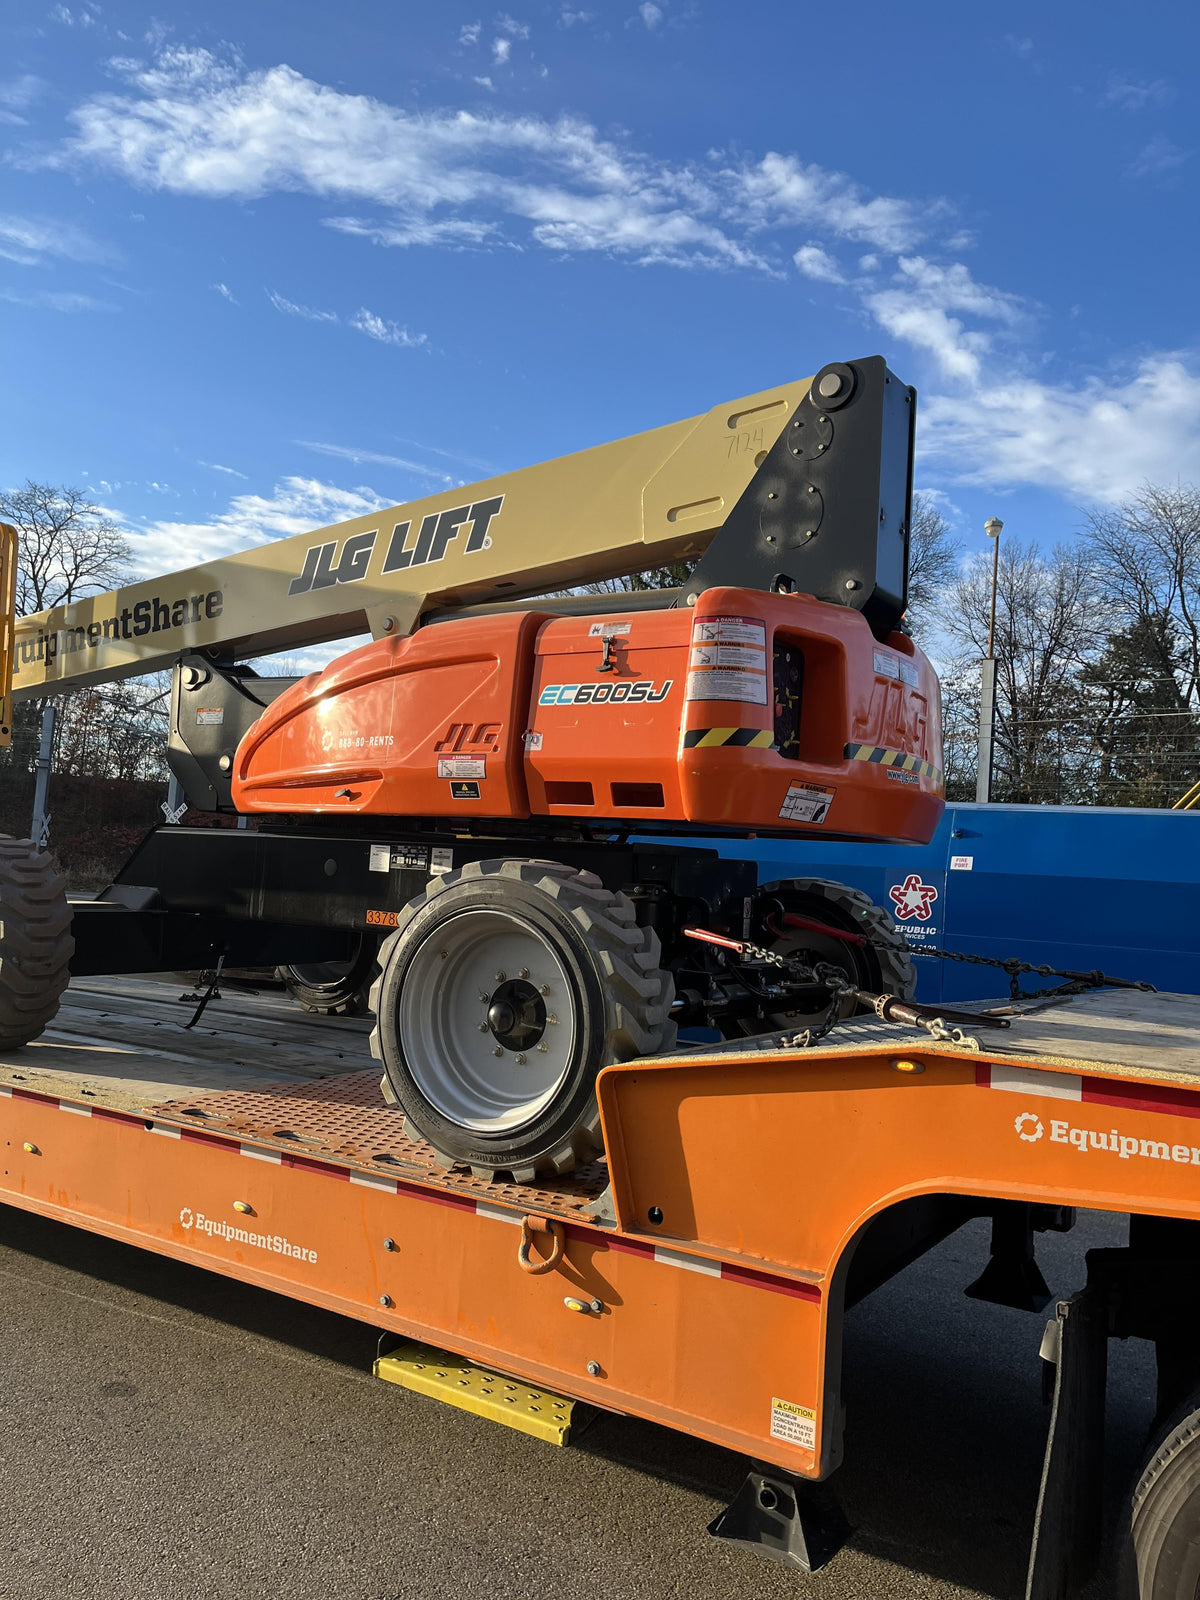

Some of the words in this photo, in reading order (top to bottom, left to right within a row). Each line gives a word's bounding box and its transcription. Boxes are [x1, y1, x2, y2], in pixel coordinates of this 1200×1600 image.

[722, 427, 764, 459] 7124
[288, 529, 379, 597] JLG
[381, 494, 505, 575] LIFT
[13, 590, 223, 674] uipmentShare
[539, 680, 673, 705] EC600SJ
[434, 723, 503, 753] JLG
[367, 911, 399, 926] 3378
[895, 925, 937, 935] EPUBLIC
[195, 1213, 318, 1264] EquipmentShare
[774, 1410, 797, 1420] MAXIMUM
[783, 1404, 813, 1418] CAUTION
[773, 1416, 813, 1432] CONCENTRATED
[773, 1422, 787, 1430] LOAD
[773, 1428, 787, 1436] AREA
